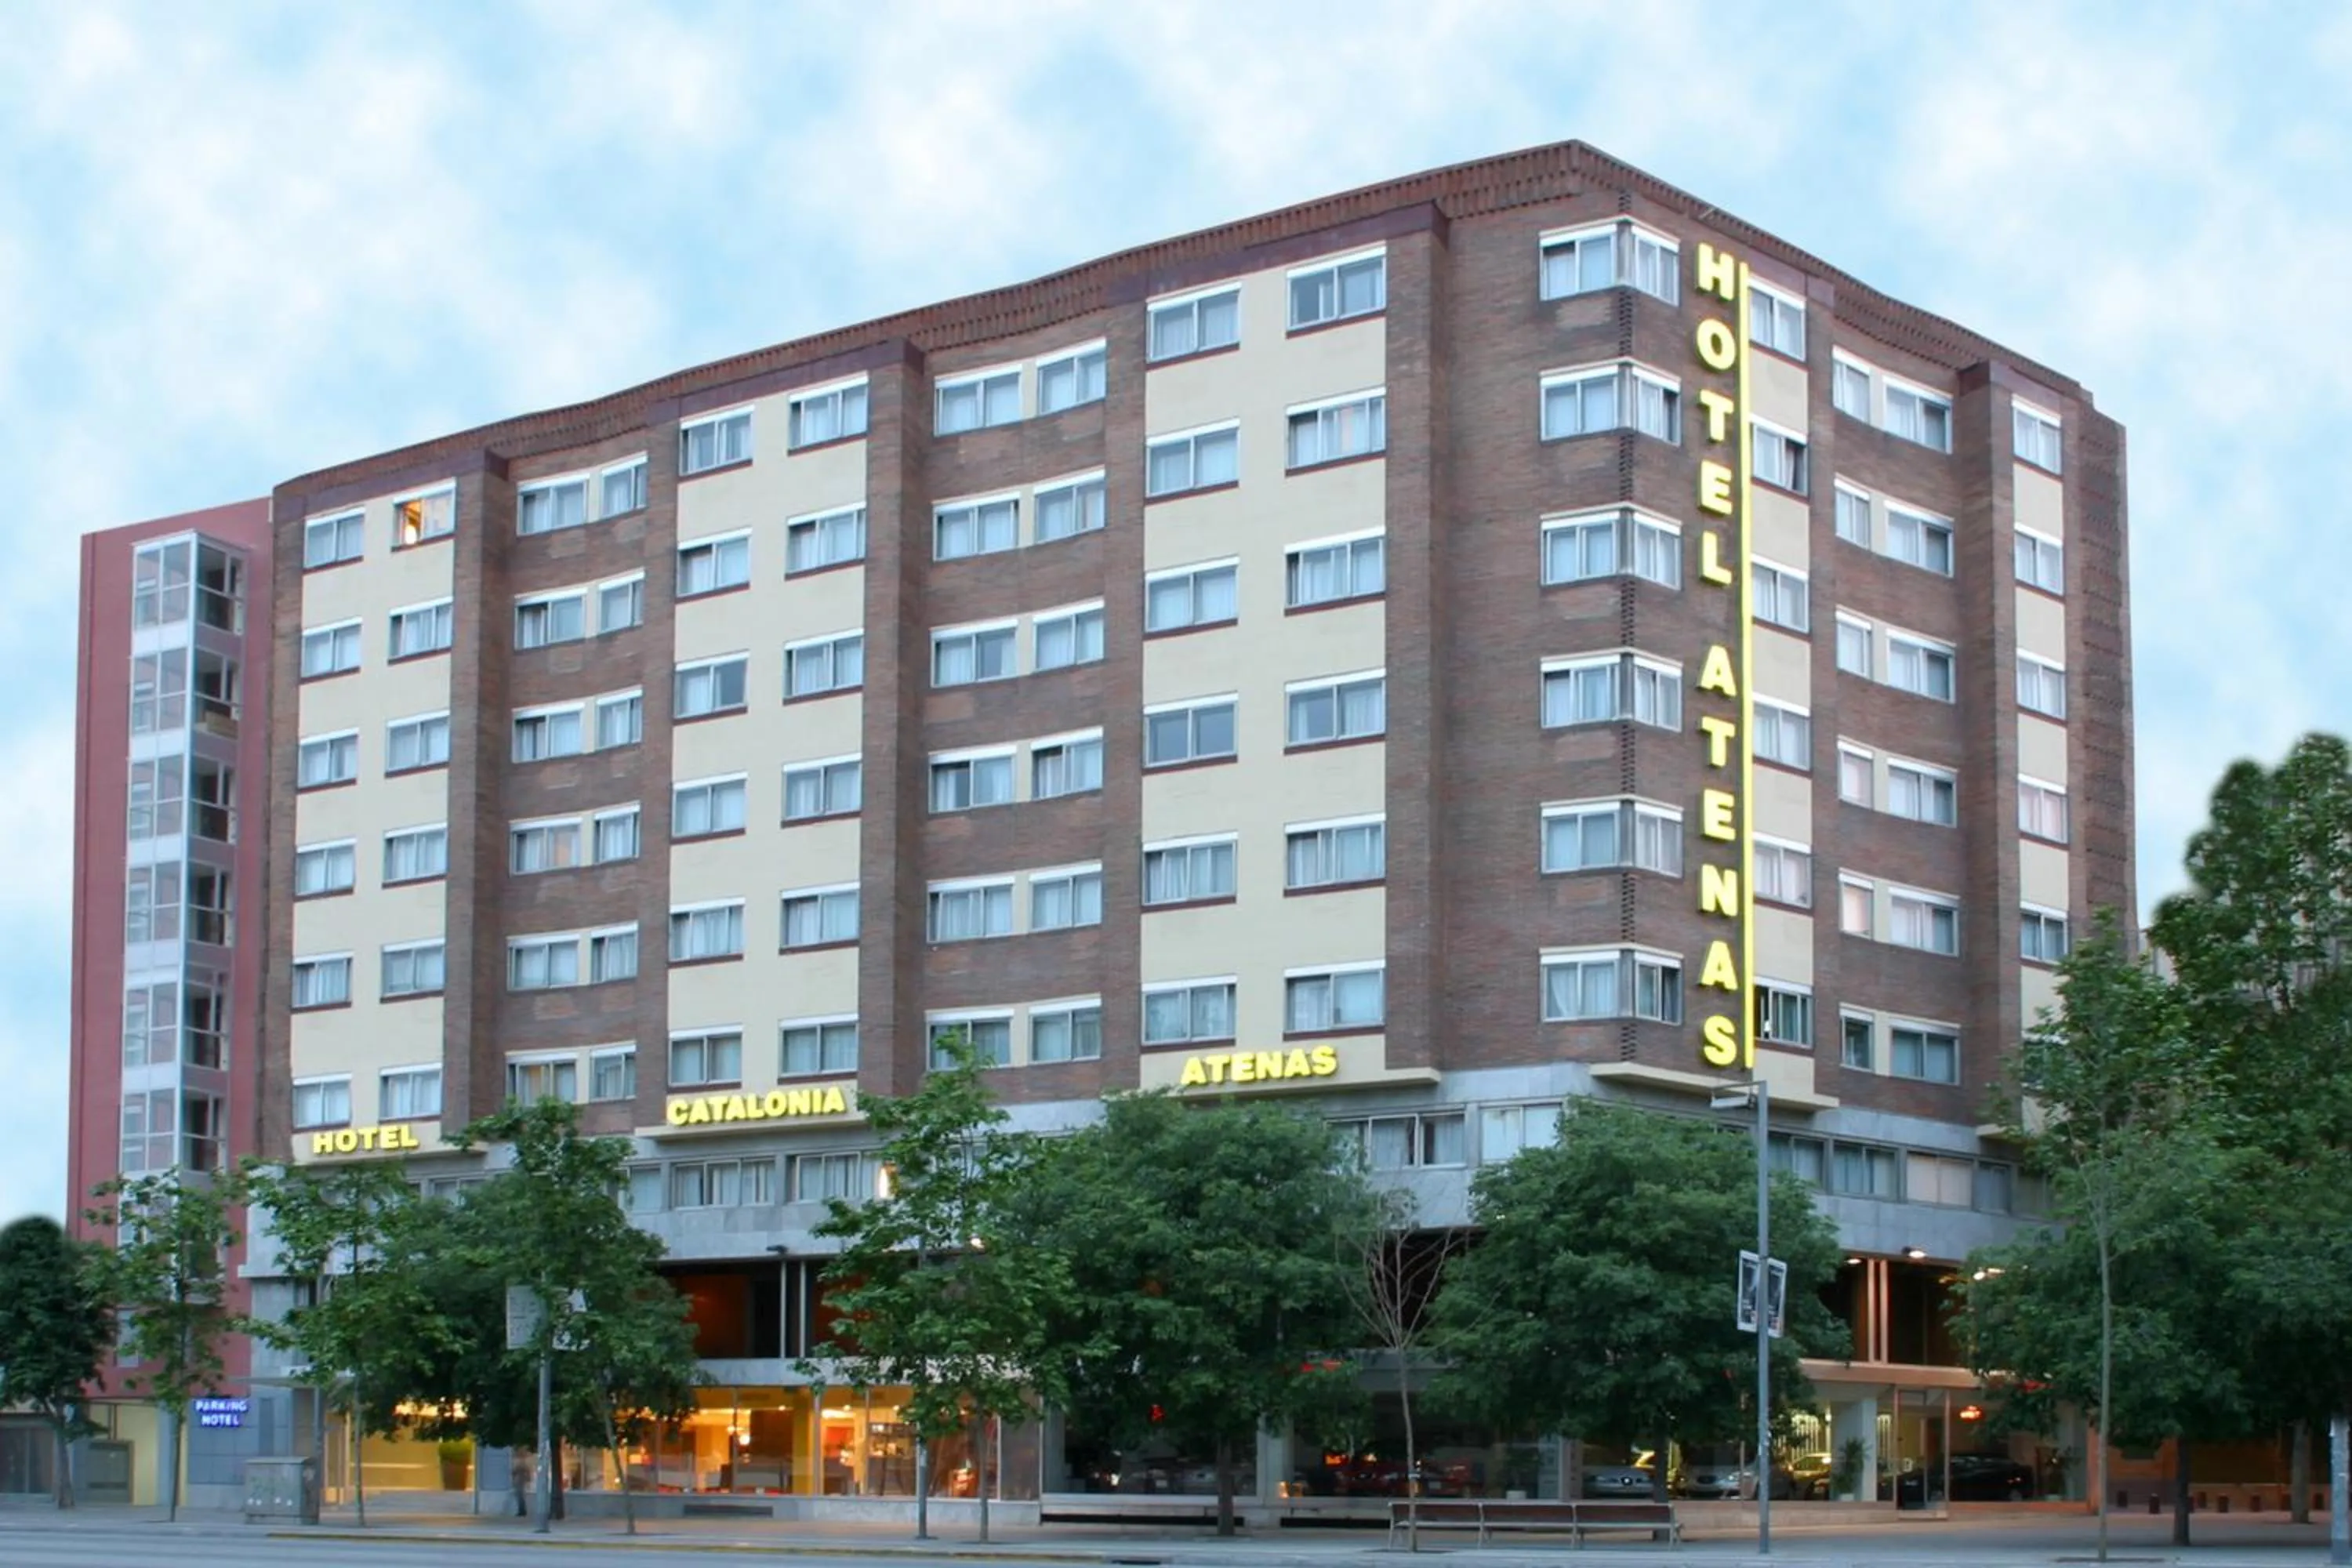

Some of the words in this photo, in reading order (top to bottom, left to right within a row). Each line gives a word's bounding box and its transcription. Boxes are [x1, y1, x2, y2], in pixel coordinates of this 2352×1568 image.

[1695, 242, 1736, 586] HOTEL
[1697, 644, 1738, 1065] ATENAS
[1181, 1045, 1338, 1085] ATENAS
[666, 1086, 846, 1126] CATALONIA
[313, 1123, 419, 1154] HOTEL
[195, 1399, 248, 1412] PARKING
[201, 1414, 240, 1426] HOTEL
